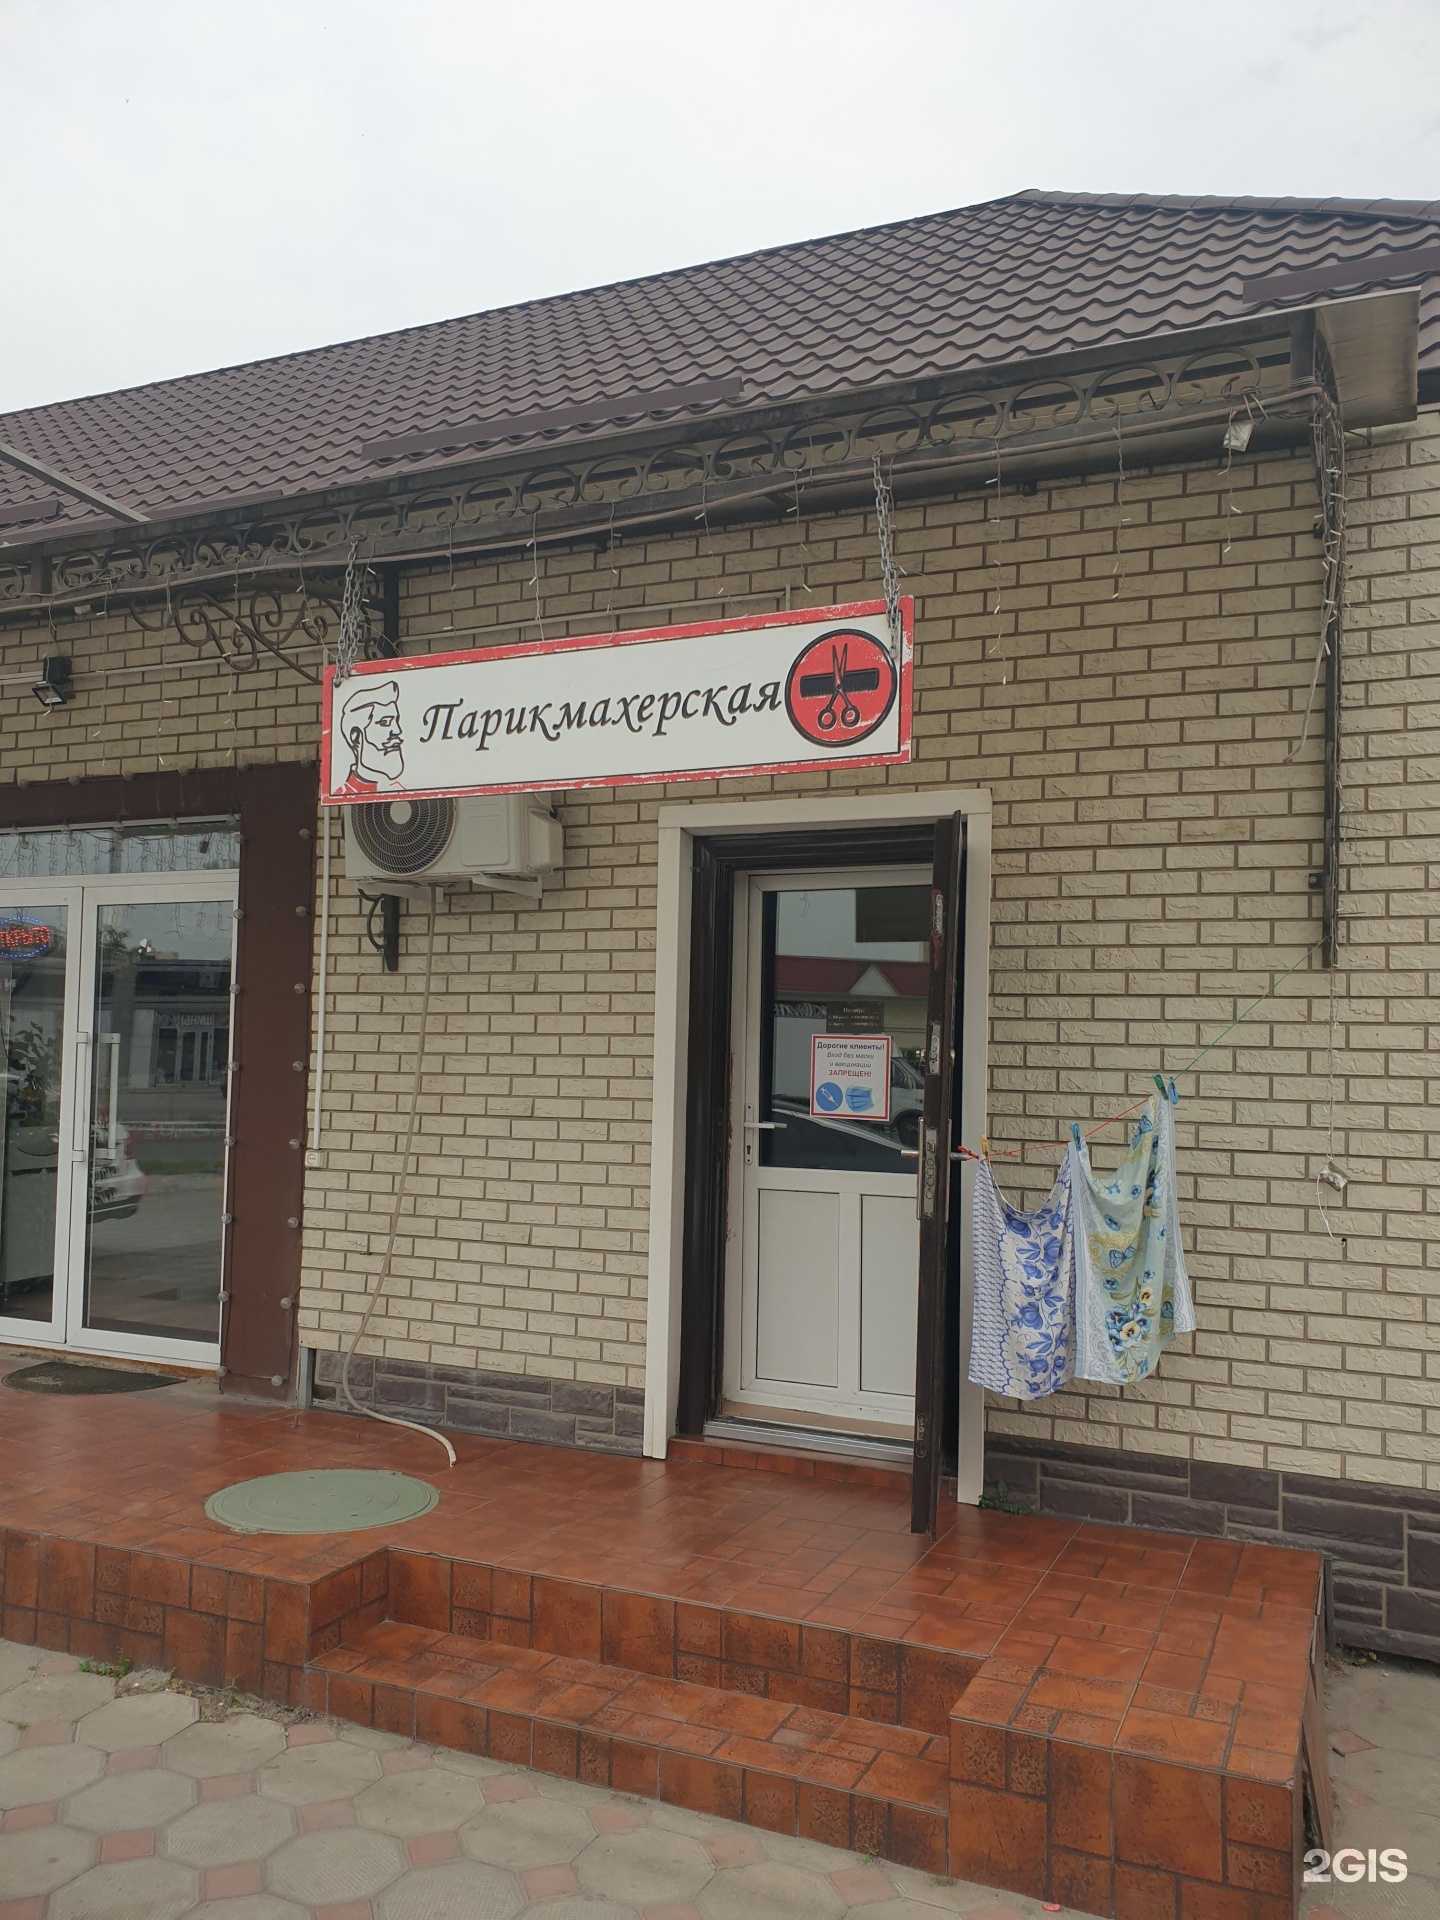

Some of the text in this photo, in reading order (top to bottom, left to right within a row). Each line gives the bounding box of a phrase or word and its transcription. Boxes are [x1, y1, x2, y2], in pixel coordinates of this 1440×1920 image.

[419, 680, 782, 751] Парикмахерская
[817, 1041, 885, 1050] Дорогие клиенты!
